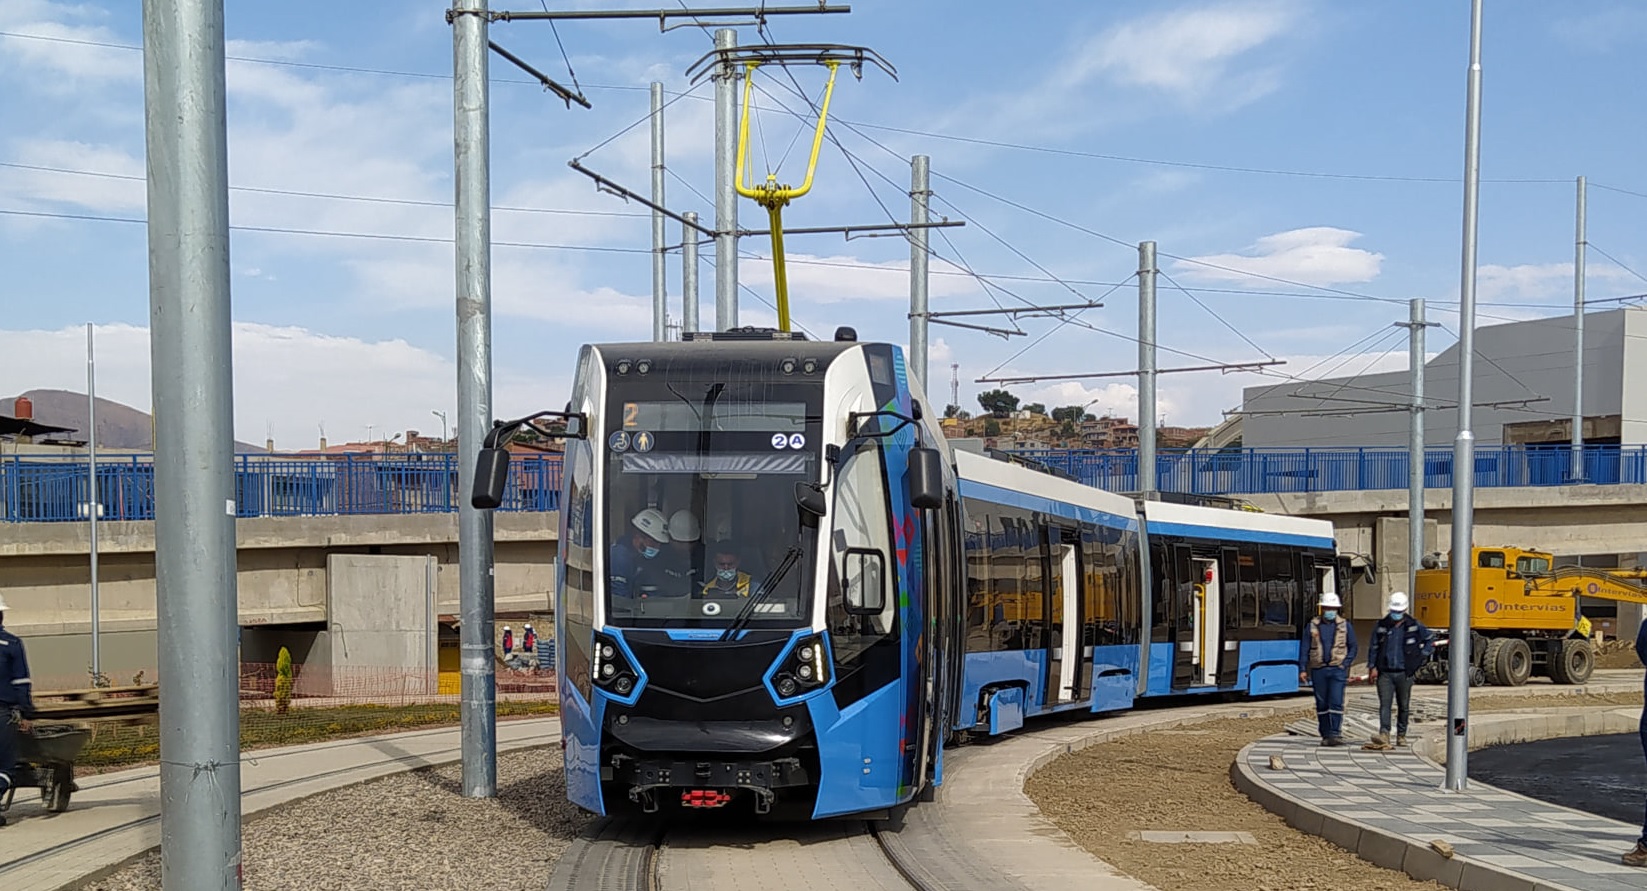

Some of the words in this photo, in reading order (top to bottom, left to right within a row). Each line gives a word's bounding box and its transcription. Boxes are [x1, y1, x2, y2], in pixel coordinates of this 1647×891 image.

[624, 403, 638, 426] 2
[774, 436, 785, 446] 2
[791, 436, 803, 445] A
